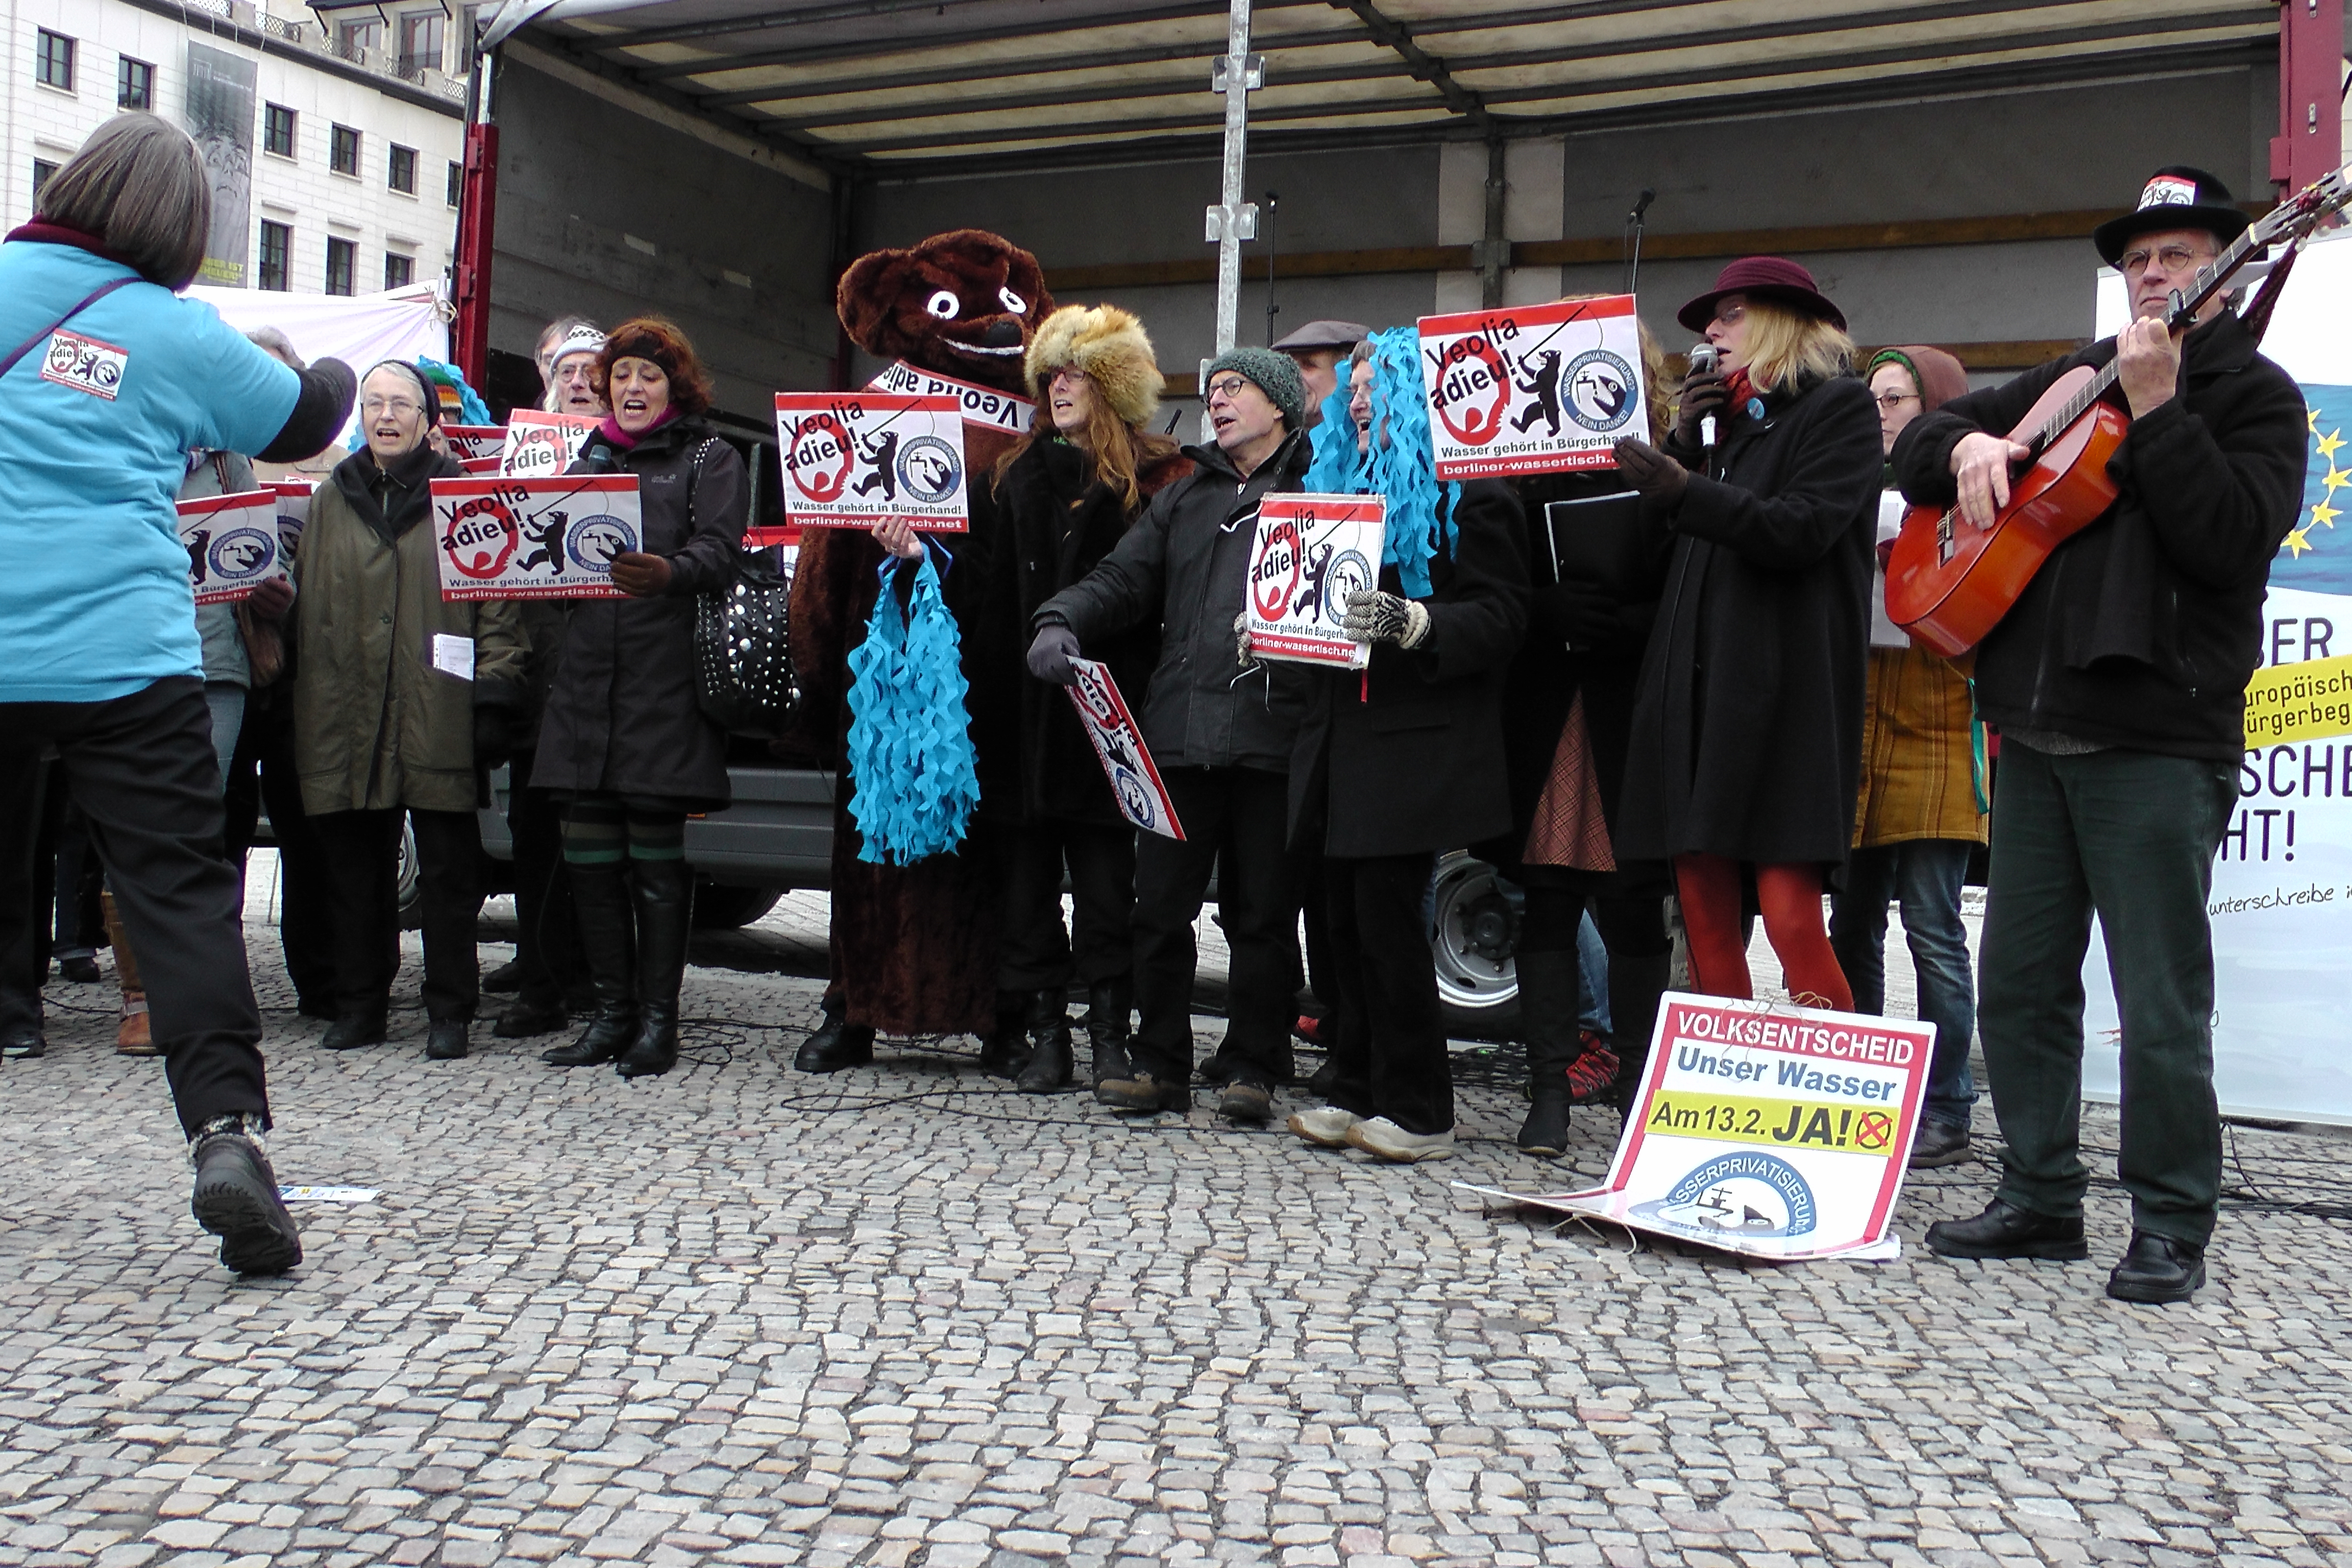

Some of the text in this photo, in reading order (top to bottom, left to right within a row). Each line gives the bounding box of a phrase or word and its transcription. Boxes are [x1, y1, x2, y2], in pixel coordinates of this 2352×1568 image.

[1425, 318, 1520, 371] Veolia
[1430, 348, 1517, 410] adieu!
[1563, 351, 1635, 398] WASSERPRIVATISIERUNG?
[512, 420, 585, 447] Veolia
[781, 400, 865, 439] Veolia
[1576, 413, 1597, 429] NEIN
[504, 441, 574, 472] adieu!
[784, 426, 860, 471] adieu!
[1441, 446, 1489, 458] Wasser
[1494, 440, 1537, 457] gehört
[1541, 439, 1553, 451] in
[1444, 454, 1615, 474] berliner-wassertisch.
[437, 484, 531, 522] Veolia
[793, 501, 962, 515] Wasser gehört in Bürgerhand!
[440, 507, 526, 551] adieu!
[1259, 507, 1314, 549] Veolia
[1252, 537, 1306, 583] adieu!
[449, 578, 496, 587] Wasser
[500, 577, 541, 587] gehört
[544, 575, 556, 584] in
[1252, 618, 1279, 631] Wasser
[1280, 623, 1303, 634] gehört
[2258, 617, 2333, 669] ER
[2247, 701, 2350, 736] ürgerbeg
[2221, 808, 2295, 862] HT!
[2209, 883, 2334, 917] unterschreibe
[1678, 1011, 1914, 1064] VOLKSENTSCHEID
[1678, 1045, 1897, 1101] Unser Wasser
[1651, 1101, 1853, 1146] Am 13.2. JA!
